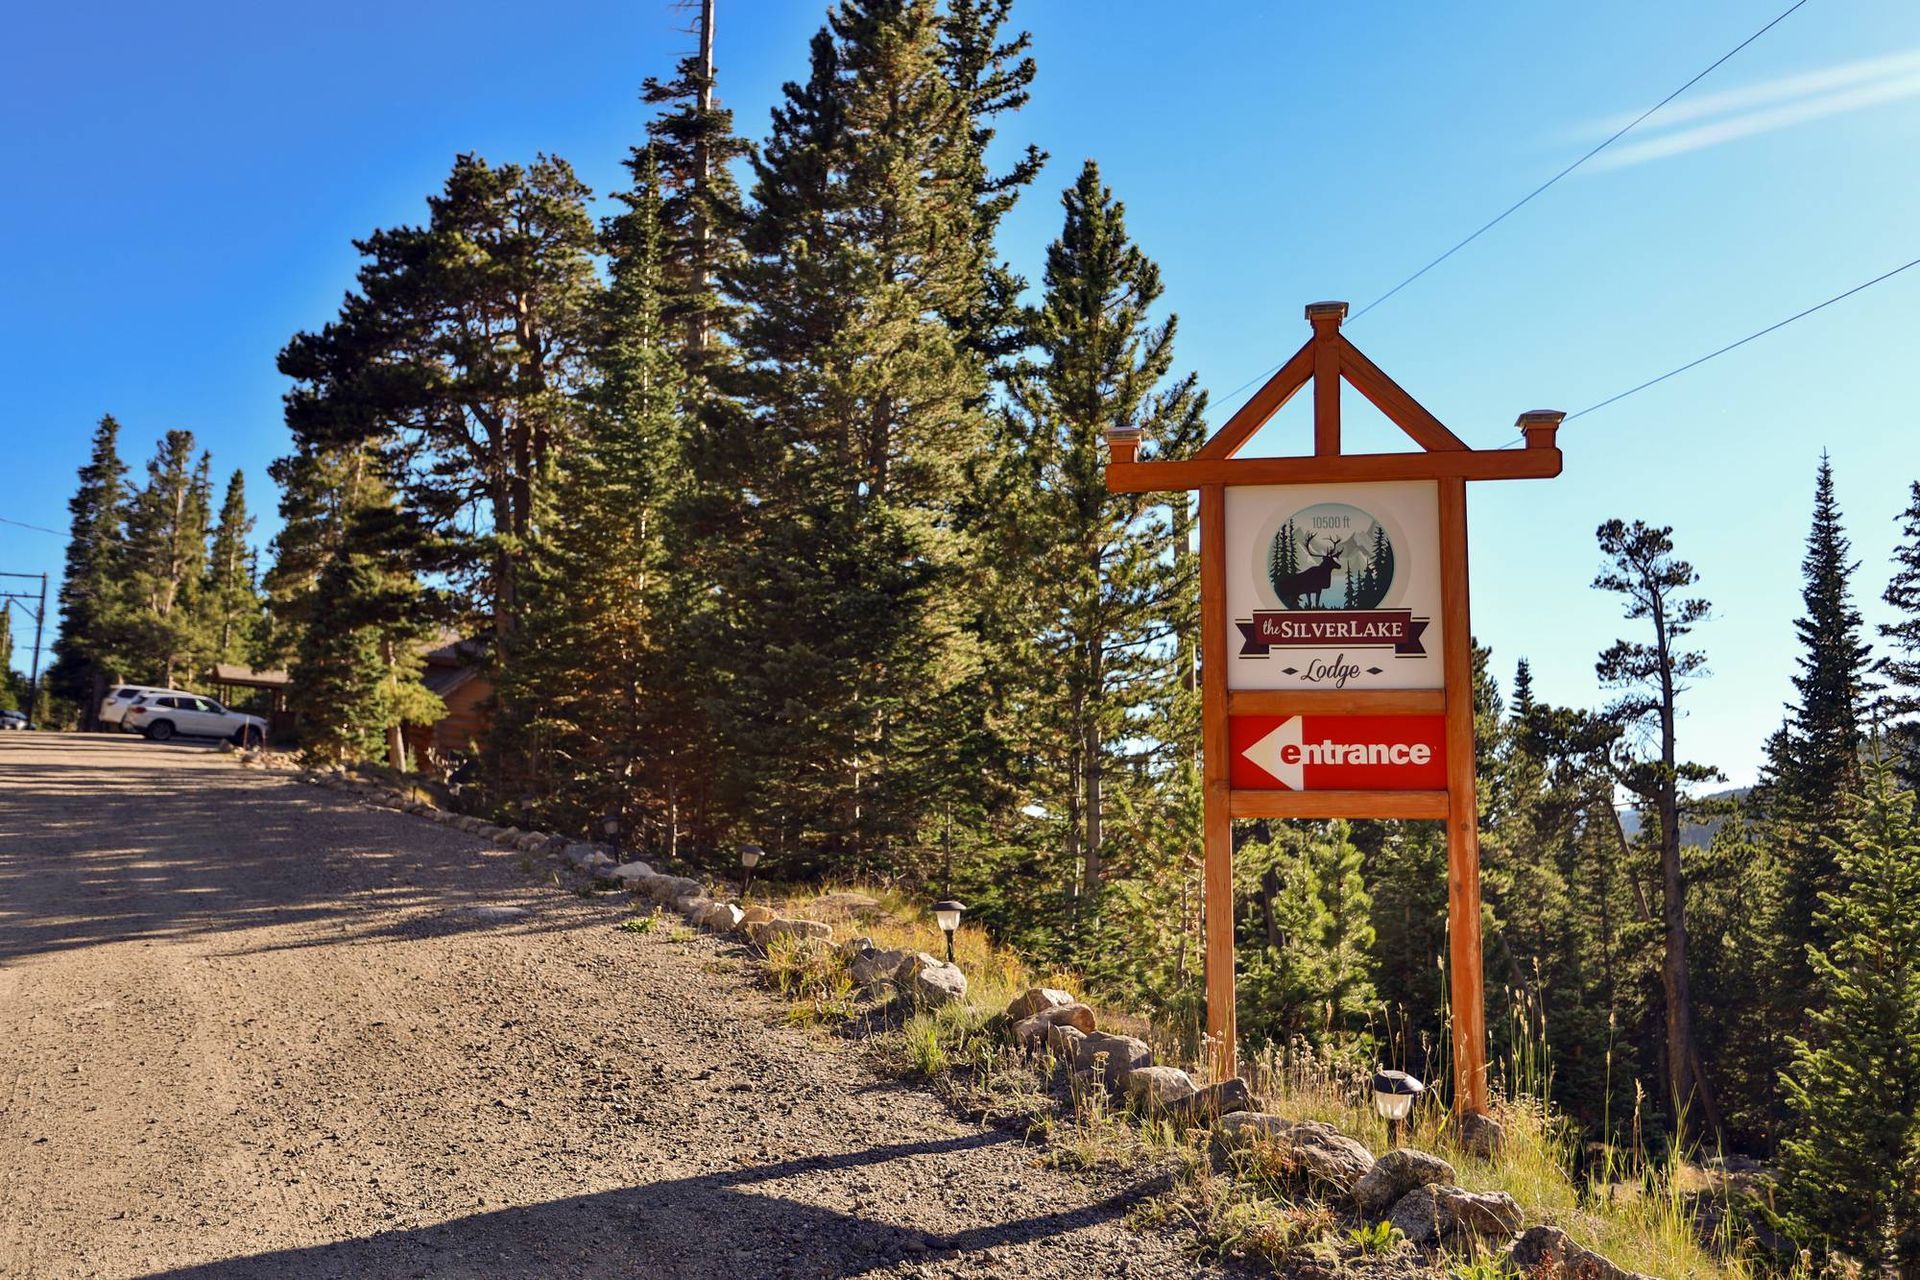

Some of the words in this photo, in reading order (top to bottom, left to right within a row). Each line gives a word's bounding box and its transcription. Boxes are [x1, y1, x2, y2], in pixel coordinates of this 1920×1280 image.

[1312, 516, 1340, 529] 10500
[1342, 515, 1350, 529] ft
[1262, 618, 1280, 635] the
[1300, 653, 1361, 688] Lodge
[1280, 739, 1431, 765] entrance
